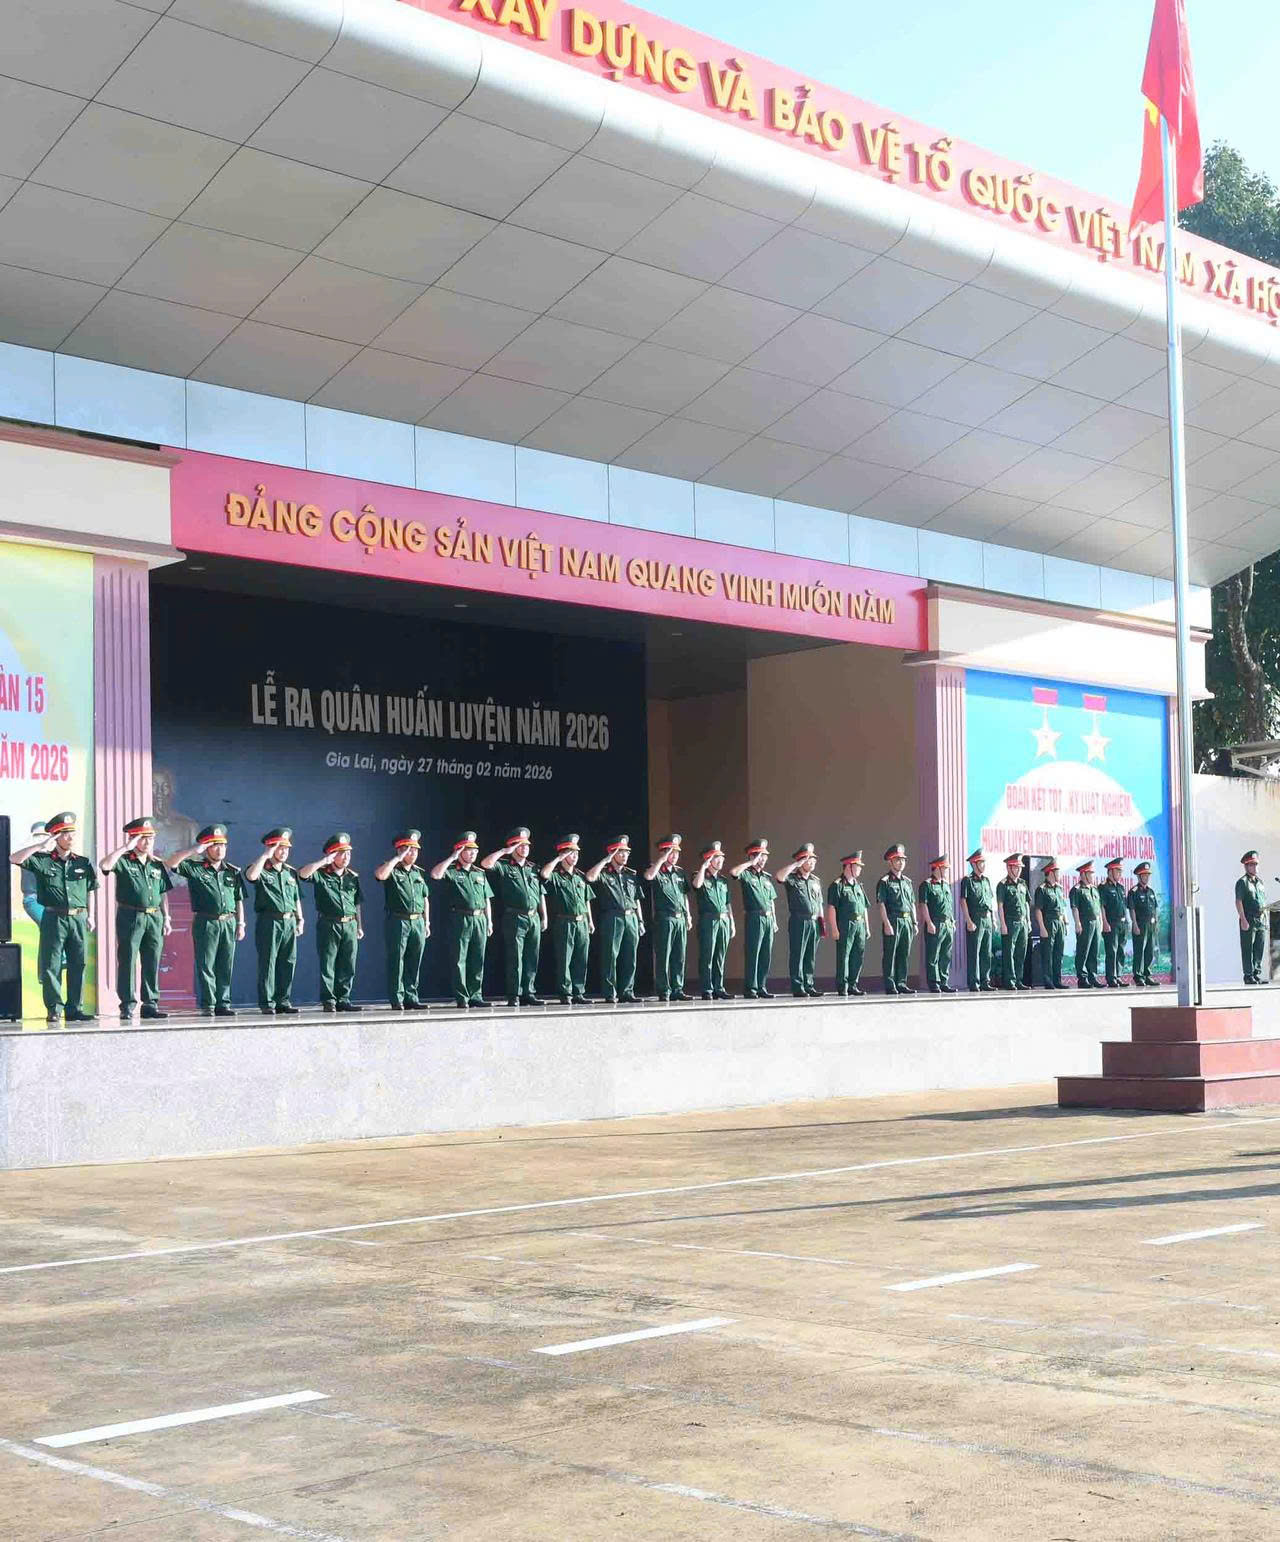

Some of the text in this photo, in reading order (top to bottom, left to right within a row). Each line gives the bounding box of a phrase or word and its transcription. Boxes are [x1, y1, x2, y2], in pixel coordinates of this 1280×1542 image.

[570, 8, 699, 93] DỰNG
[703, 58, 758, 120] VÀ
[768, 83, 848, 150] BẢO
[856, 121, 901, 183] VỆ
[906, 137, 954, 191] TỔ
[967, 172, 1062, 232] QUỐC
[1069, 206, 1127, 263] VIỆT
[1206, 260, 1243, 304] XÃ
[225, 484, 896, 625] ĐẢNG CỘNG SẢN VIỆT NAM QUANG VINH MUÔN NĂM
[26, 676, 44, 714] 15
[251, 669, 609, 751] LỄ RA QUÂN HUẤN LUYỆN NĂM 2026
[31, 742, 68, 781] 2026
[326, 752, 553, 780] Gia Lai, ngày 27 tháng 02 năm 2026
